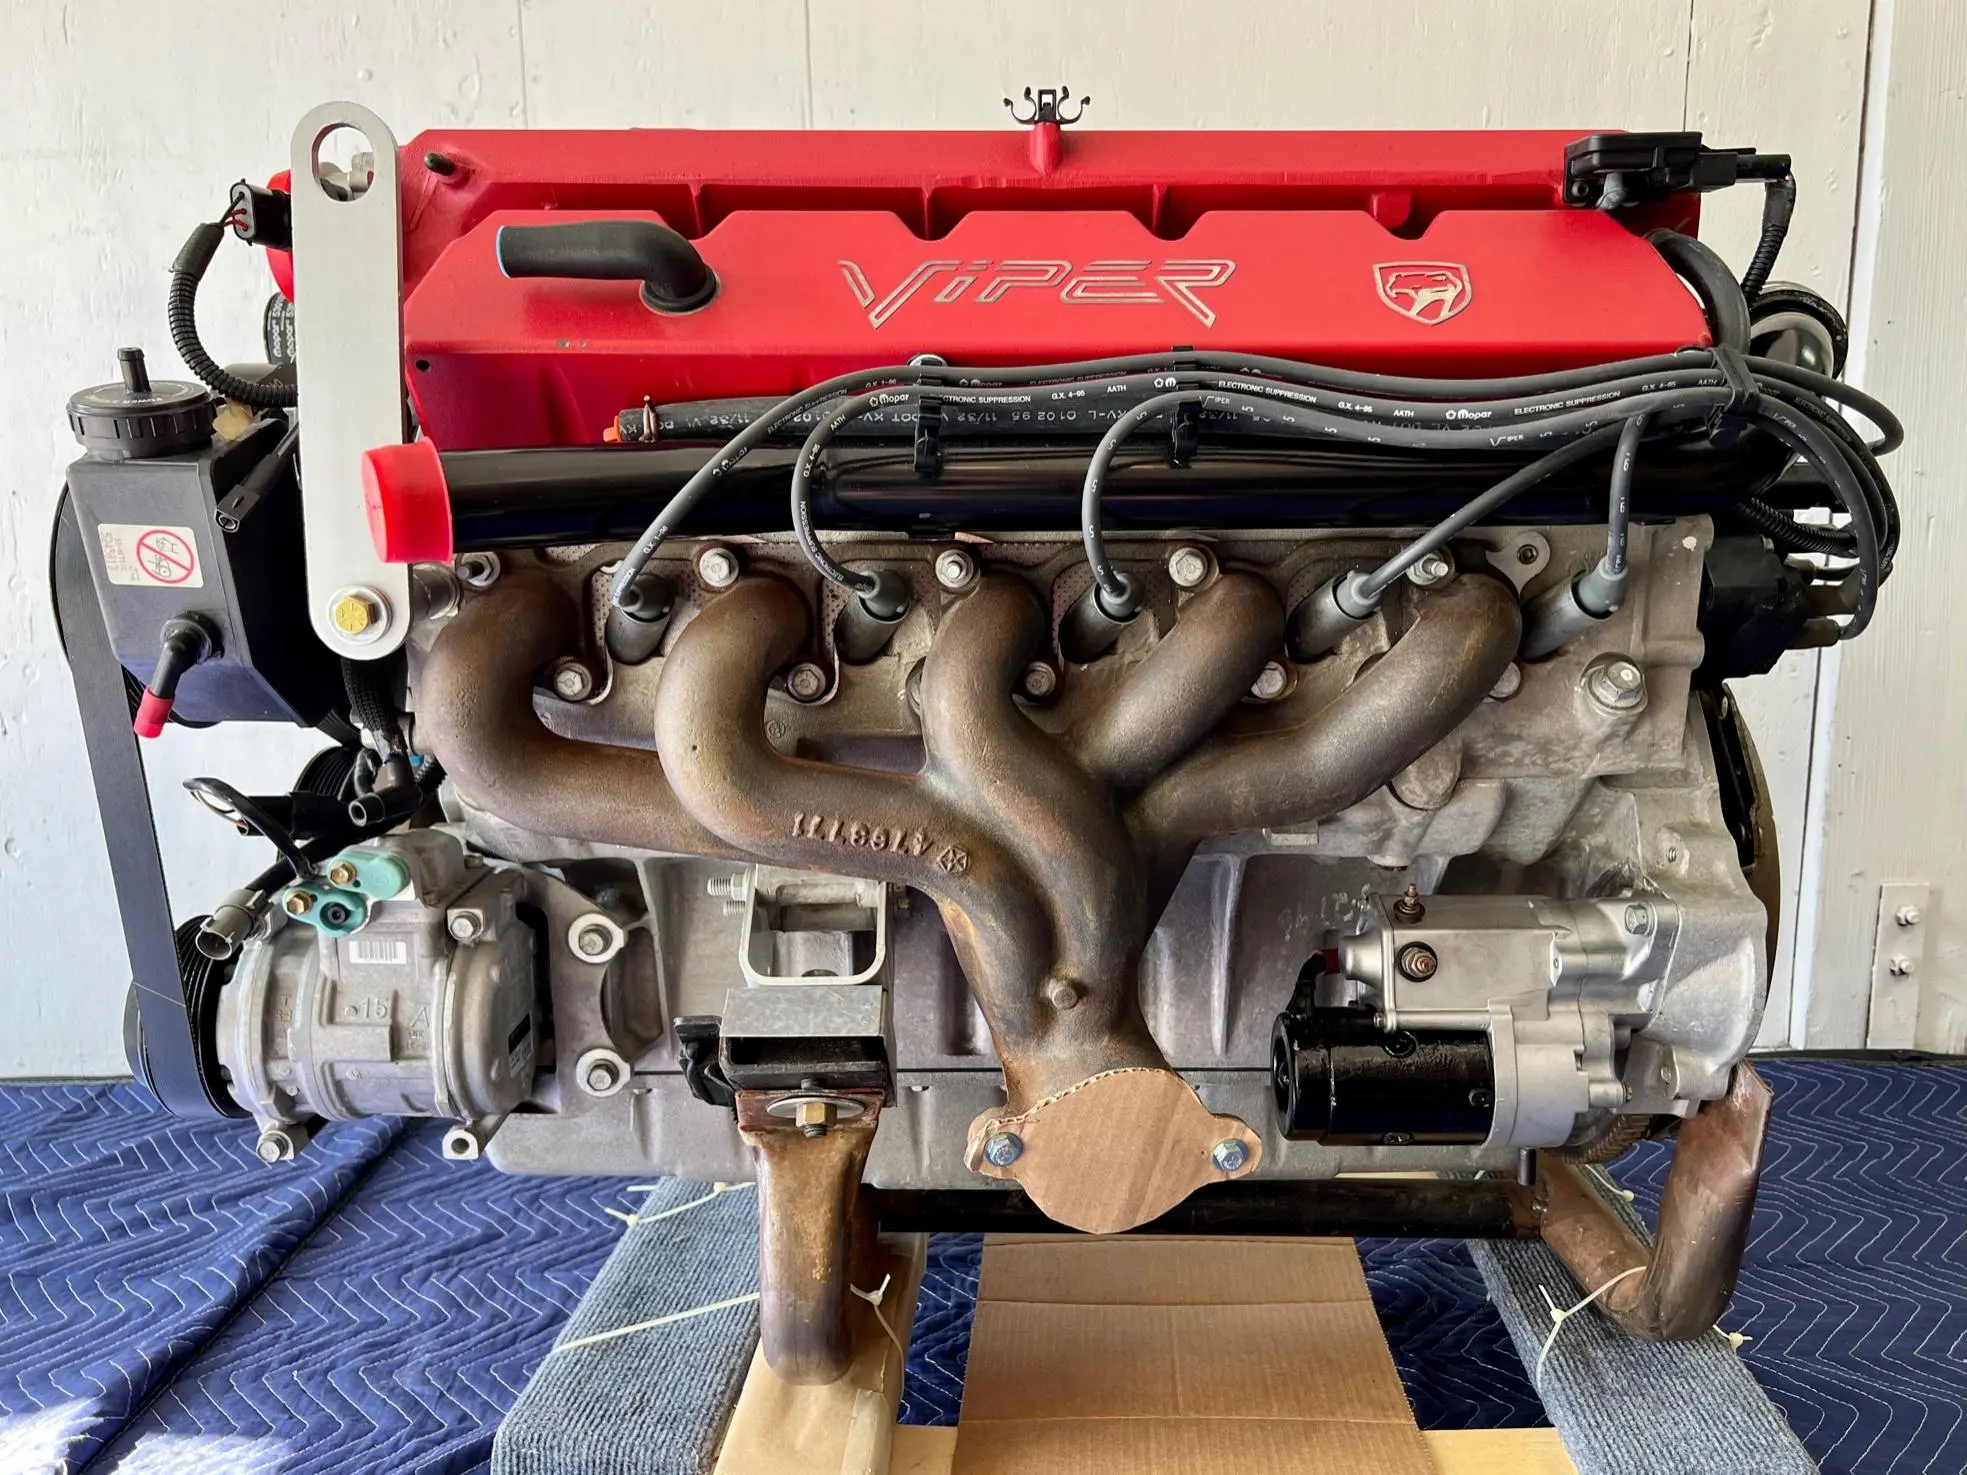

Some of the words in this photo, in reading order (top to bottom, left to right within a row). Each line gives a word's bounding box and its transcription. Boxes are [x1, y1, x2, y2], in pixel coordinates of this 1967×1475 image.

[1106, 384, 1127, 393] AATH
[1218, 380, 1264, 394] ELECTRONIC
[1265, 386, 1318, 404] SUPPRESSION
[879, 393, 910, 405] Mopar
[978, 395, 1031, 404] SUPPRESSION
[1514, 399, 1564, 415] ELECTRONIC
[1565, 390, 1621, 408] SUPPRESSION
[1393, 408, 1415, 418] AATH
[1457, 408, 1493, 421] Mopar
